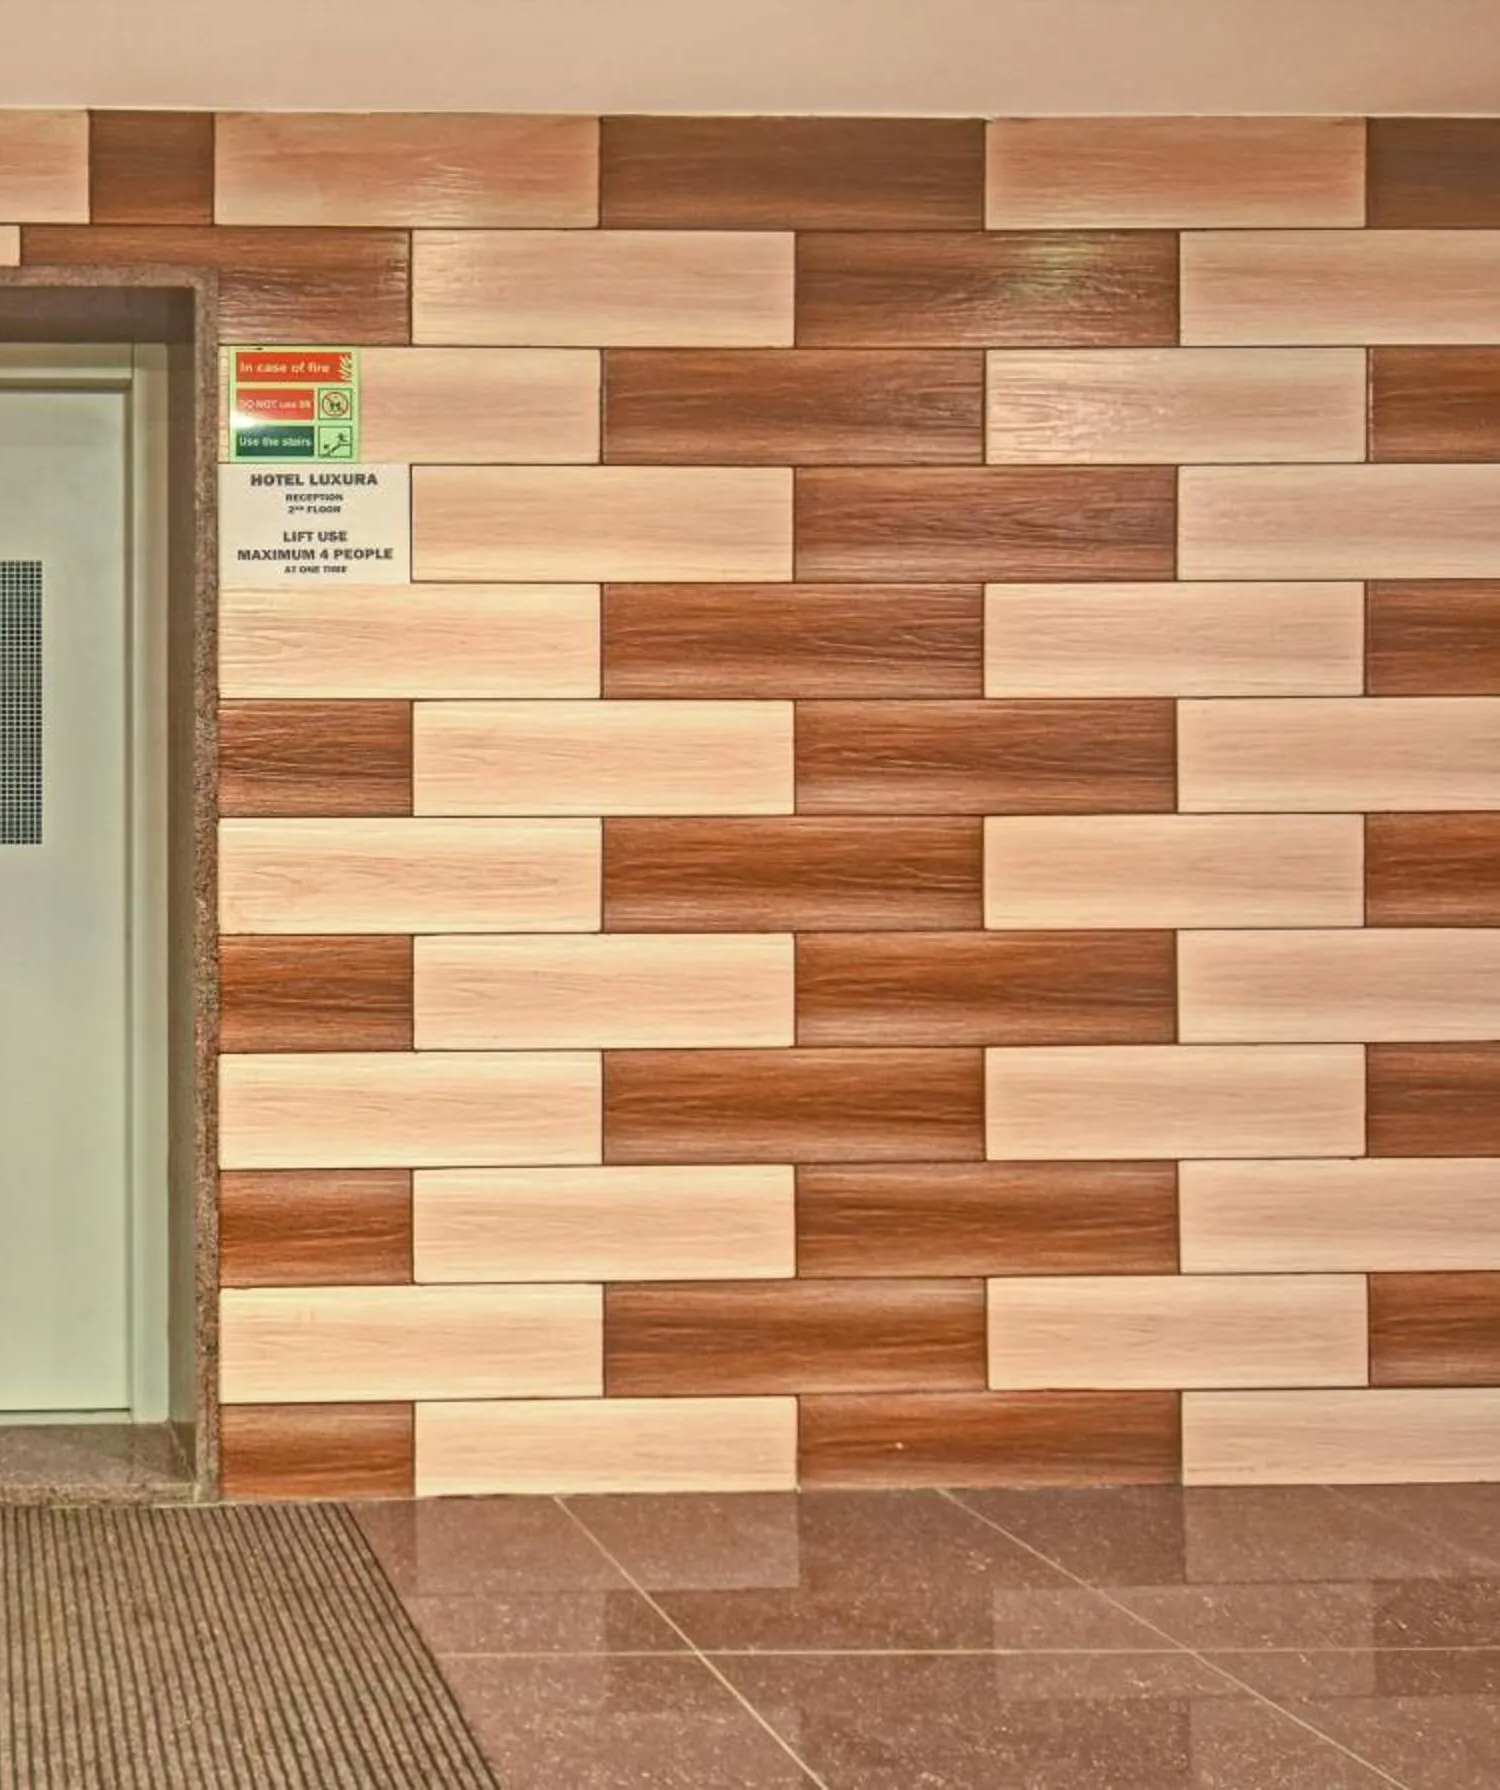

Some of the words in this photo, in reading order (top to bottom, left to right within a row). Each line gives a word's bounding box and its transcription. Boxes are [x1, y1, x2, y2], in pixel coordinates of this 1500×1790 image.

[240, 361, 253, 373] In
[256, 363, 287, 373] case
[291, 361, 305, 377] of
[307, 361, 331, 373] fire
[256, 400, 278, 409] NOT
[240, 437, 260, 447] Use
[262, 437, 279, 447] the
[250, 474, 304, 487] HOTEL
[309, 473, 378, 486] LUXURA
[285, 493, 344, 502] RECEPTION
[307, 505, 341, 514] FLOOR
[283, 531, 314, 542] LIFT
[318, 531, 347, 543] USE
[237, 549, 315, 561] MAXIMUM
[320, 549, 329, 561] 4
[333, 548, 393, 560] PEOPLE
[284, 565, 297, 574] AT
[299, 565, 320, 574] ONE
[323, 565, 347, 574] TIME
